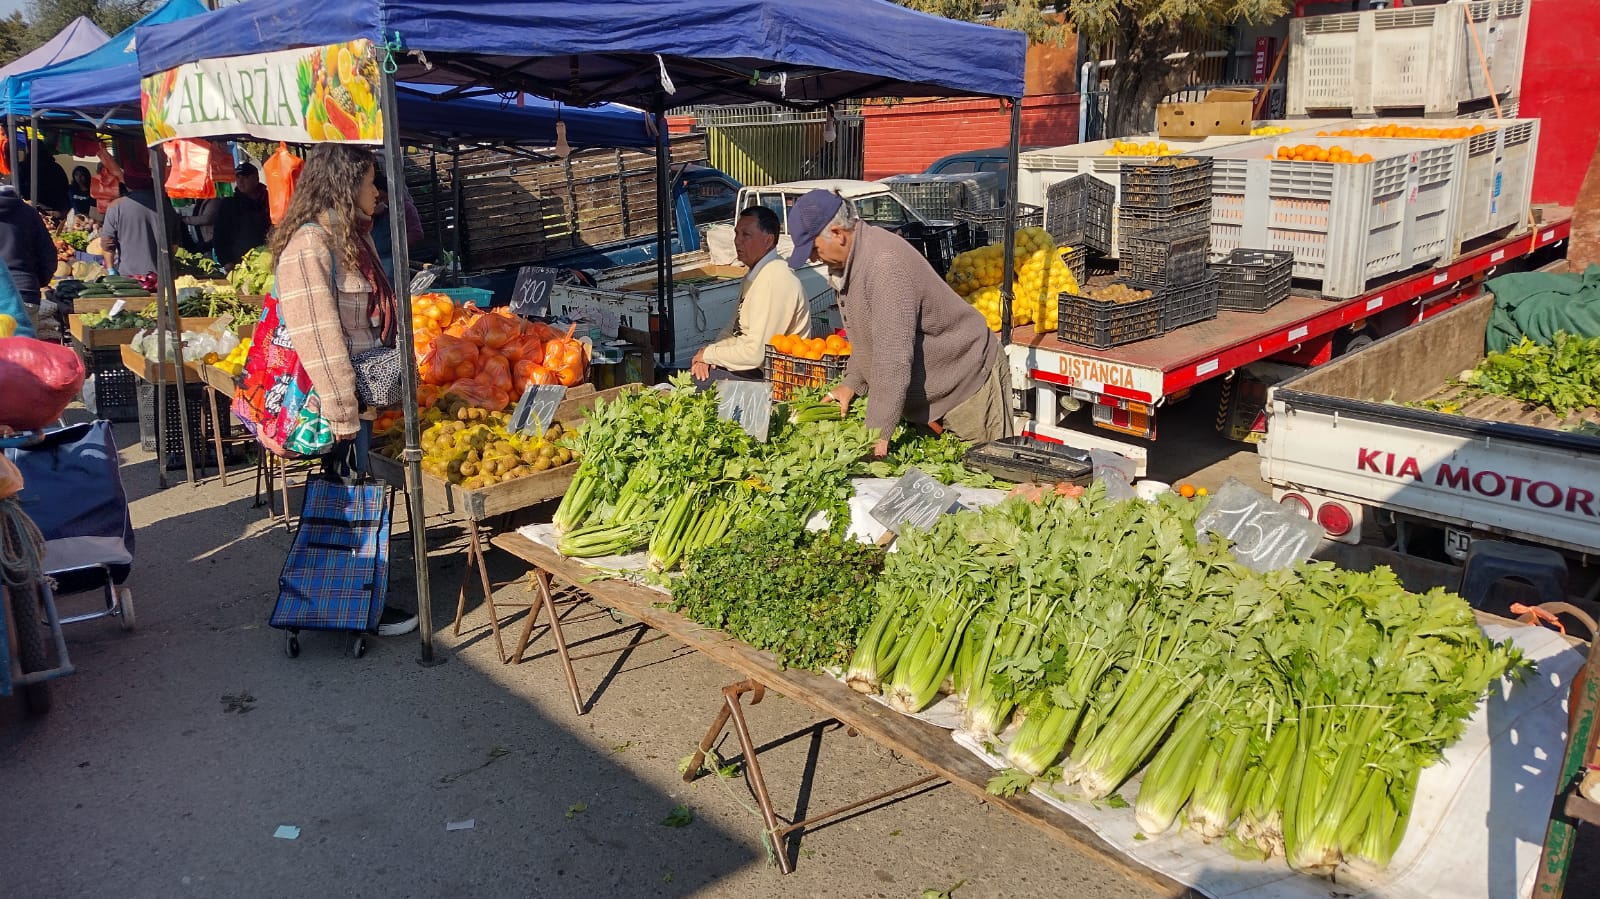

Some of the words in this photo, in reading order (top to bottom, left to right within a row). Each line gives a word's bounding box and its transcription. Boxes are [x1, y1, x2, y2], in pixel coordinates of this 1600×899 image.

[515, 277, 546, 309] 500
[1059, 355, 1135, 389] DISTANCIA
[913, 476, 945, 499] 600
[1357, 447, 1424, 483] KIA
[1435, 463, 1600, 517] MOTOR
